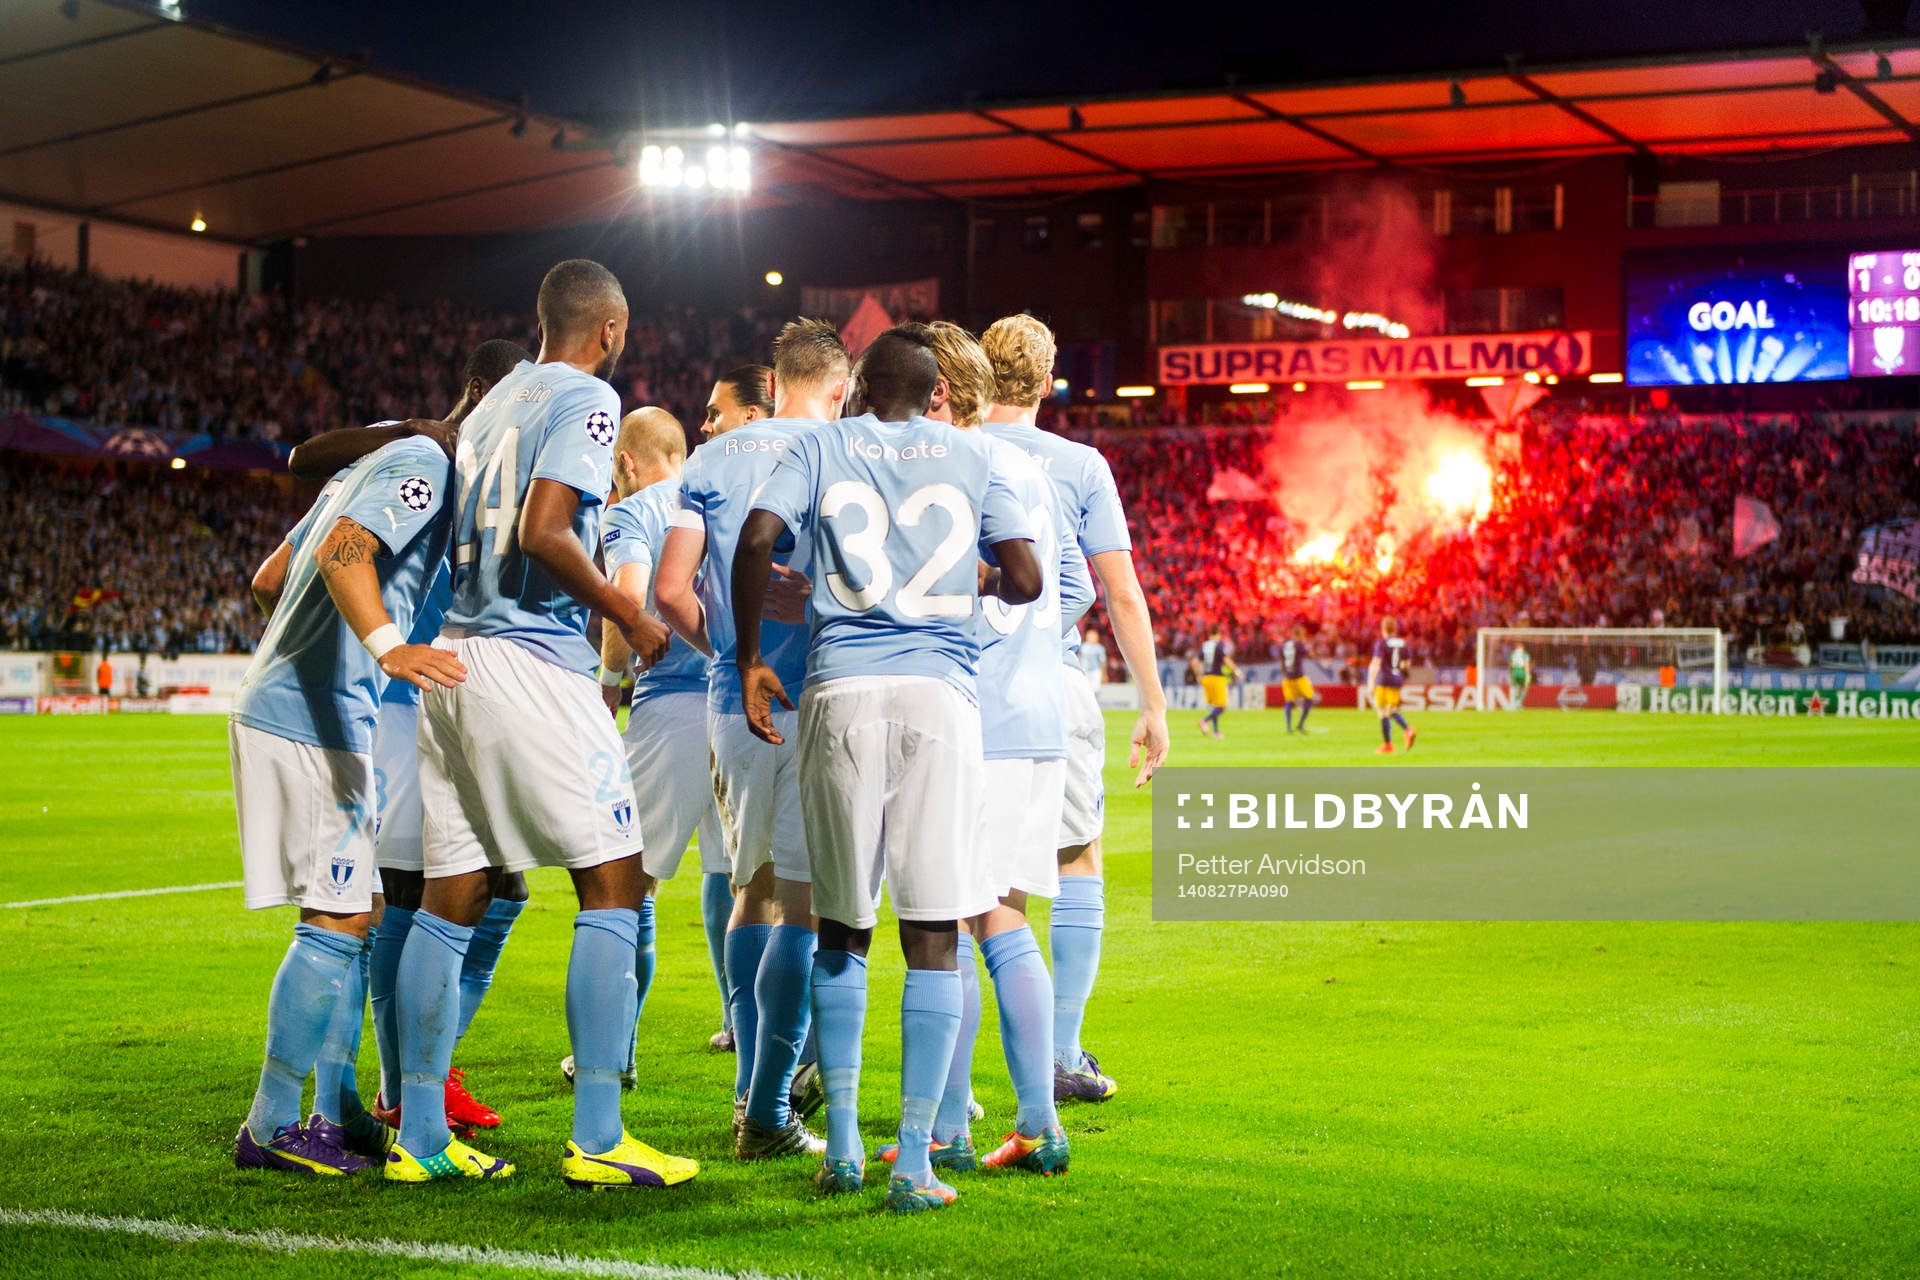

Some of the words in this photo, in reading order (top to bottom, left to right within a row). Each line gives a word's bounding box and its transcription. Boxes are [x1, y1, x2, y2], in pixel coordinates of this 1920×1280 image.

[1858, 269, 1870, 292] 1
[1904, 266, 1920, 290] 0
[1688, 300, 1775, 331] GOAL
[1858, 296, 1920, 322] 10:18
[1165, 347, 1350, 380] SUPRAS
[849, 436, 948, 461] Konate
[820, 480, 975, 618] 32
[1357, 685, 1518, 711] NSSAN
[1650, 687, 1796, 715] Heineken
